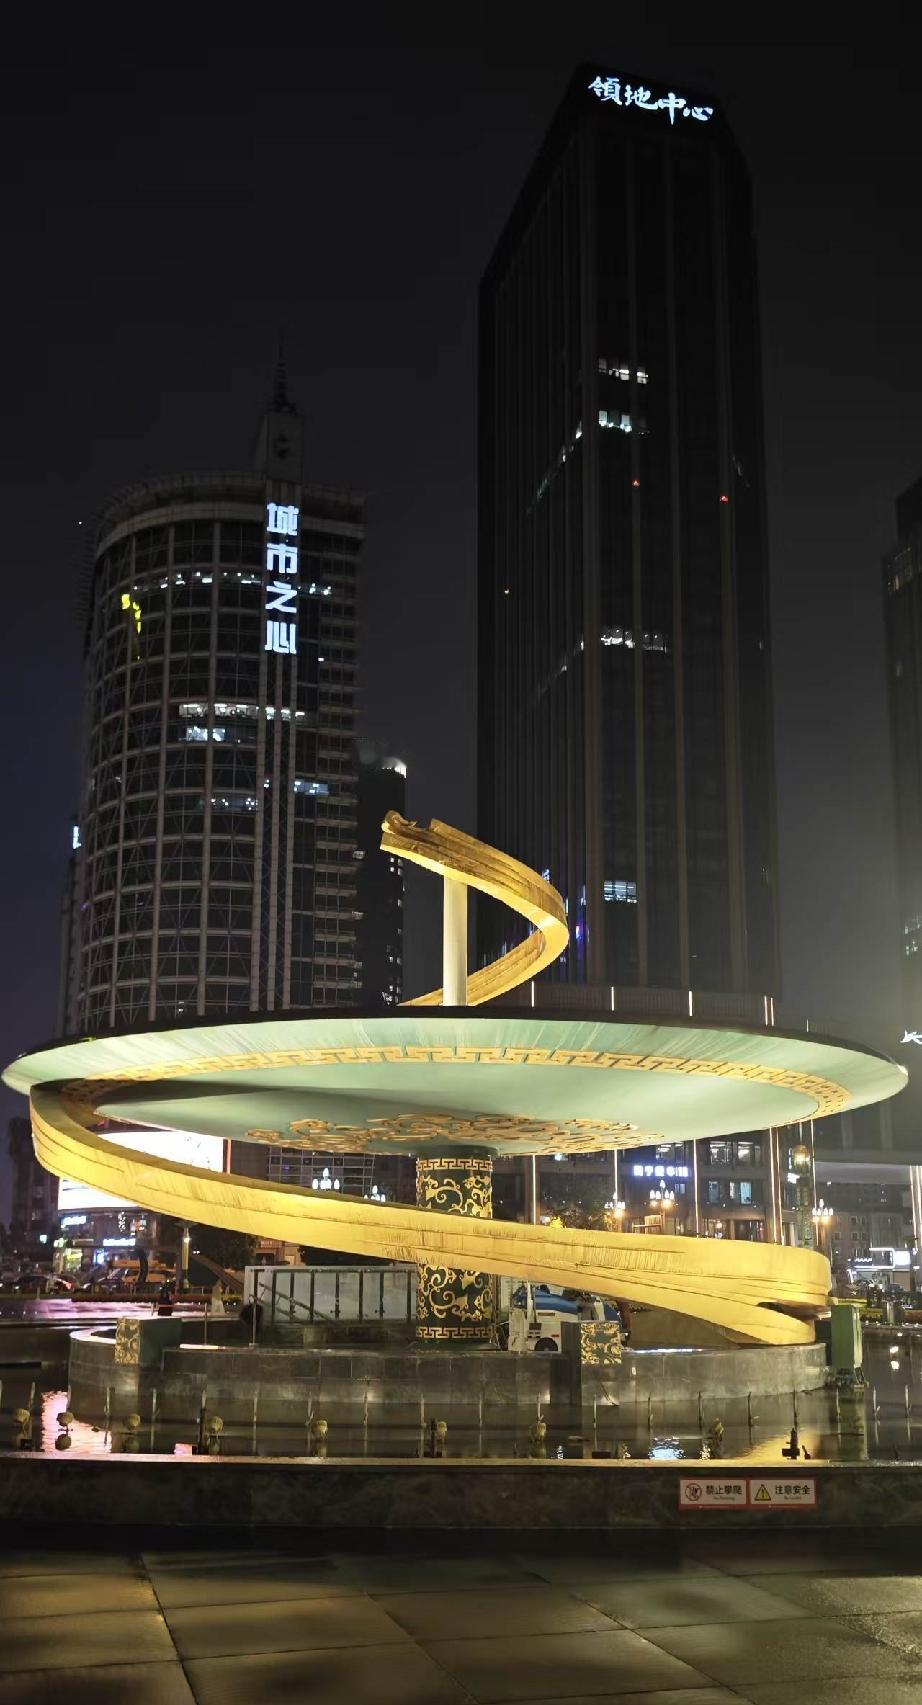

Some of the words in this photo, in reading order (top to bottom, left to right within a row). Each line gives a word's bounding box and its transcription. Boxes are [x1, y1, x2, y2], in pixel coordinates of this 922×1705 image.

[588, 76, 713, 125] 領地中心
[265, 502, 299, 654] 城市之心
[775, 1484, 811, 1495] 注意安全
